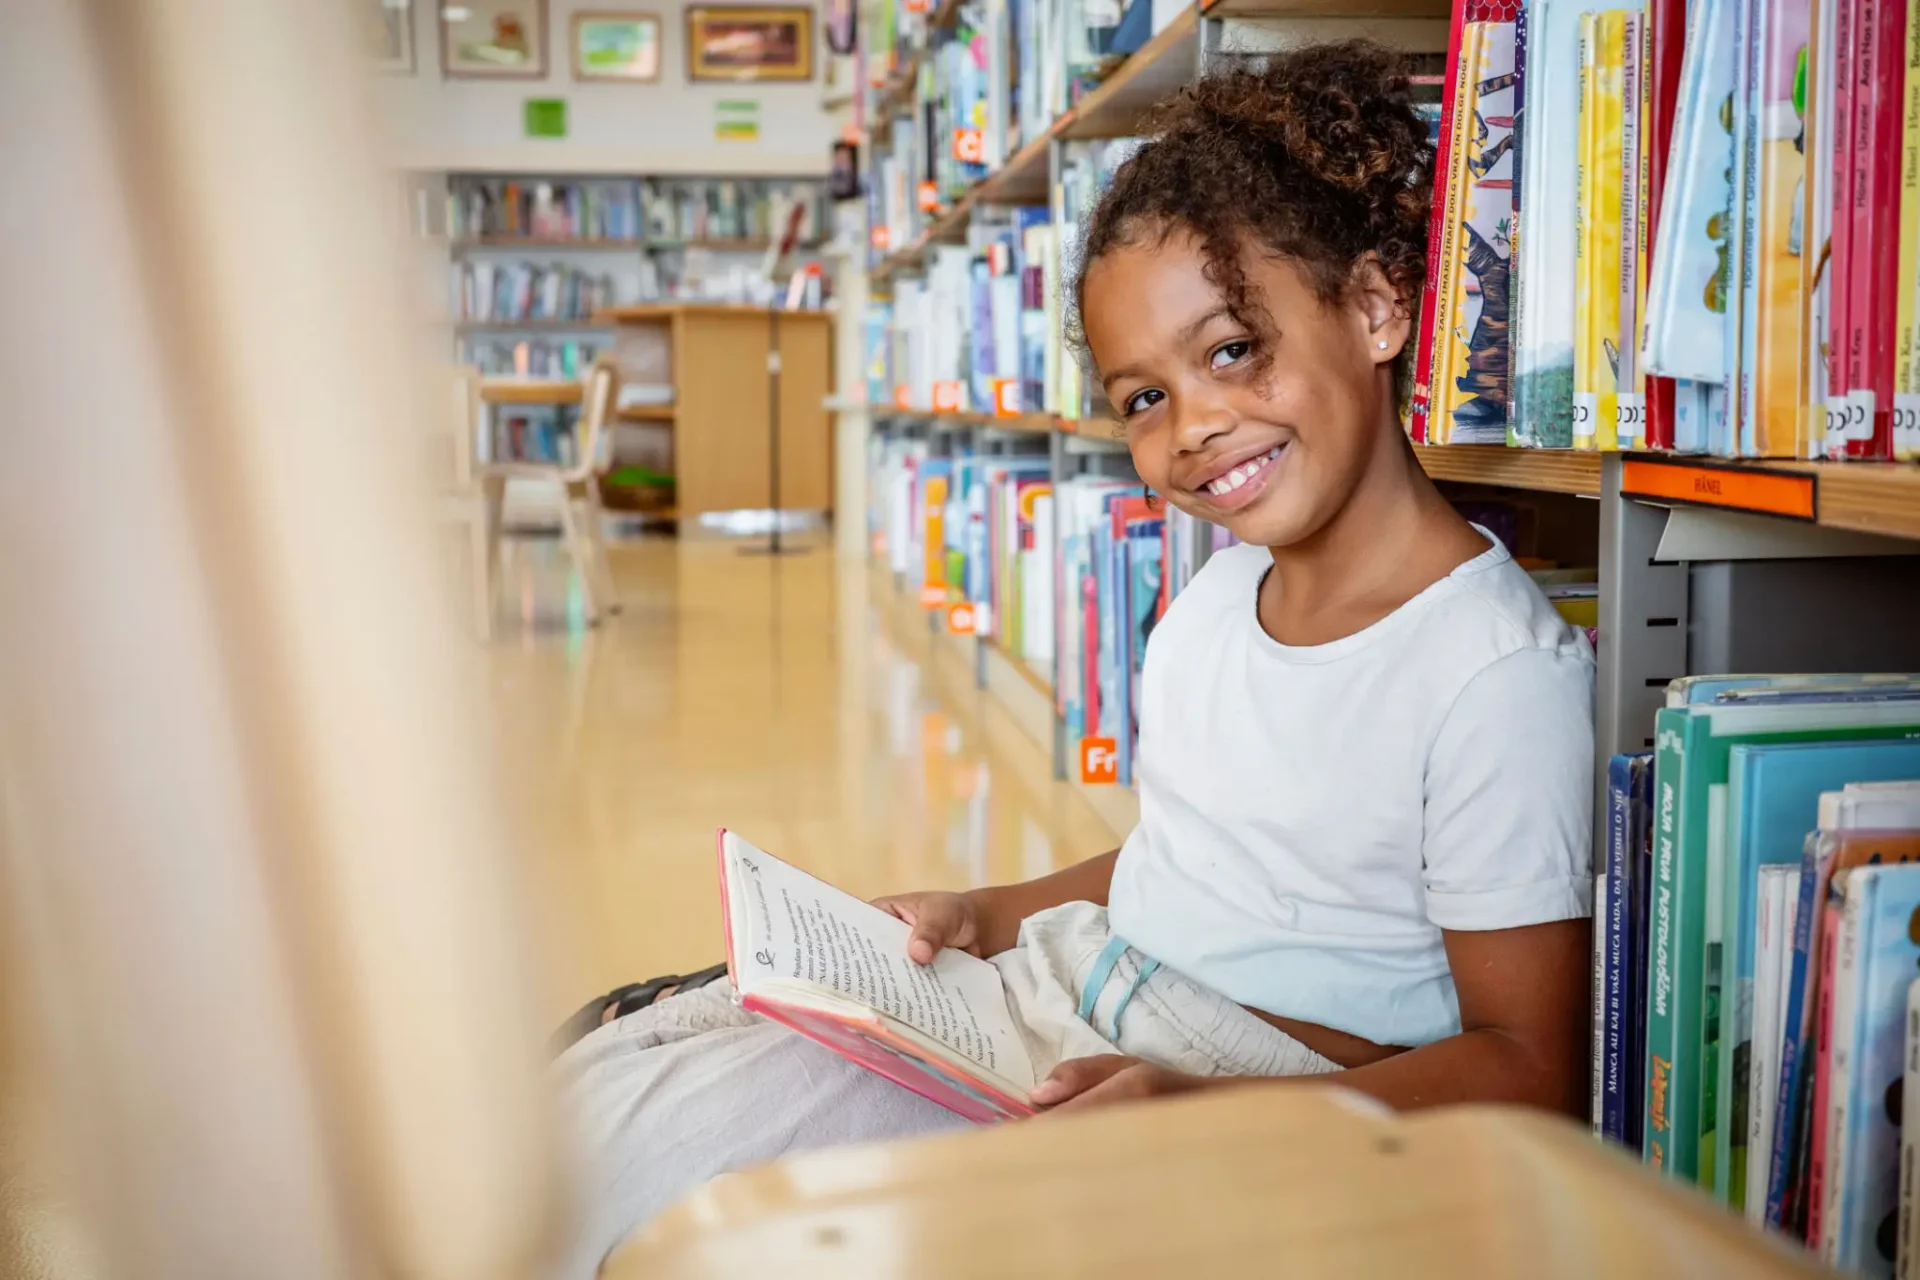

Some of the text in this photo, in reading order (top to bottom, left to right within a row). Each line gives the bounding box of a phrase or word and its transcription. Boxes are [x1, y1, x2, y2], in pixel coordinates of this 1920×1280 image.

[1624, 20, 1634, 61] Hans
[1459, 56, 1468, 89] NOGE
[1624, 64, 1634, 113] Hagen
[1456, 92, 1466, 130] DOLGE
[1454, 133, 1462, 147] IN
[1451, 151, 1460, 180] VRAT
[1448, 183, 1458, 214] DOLG
[1444, 216, 1454, 258] ŽIRAFE
[1442, 260, 1451, 295] IMAJO
[1438, 297, 1448, 332] ZAKAJ
[1430, 377, 1442, 413] Jolanda
[1615, 814, 1622, 824] O
[1662, 781, 1674, 833] MOJA
[1660, 836, 1672, 882] PRVA
[1614, 880, 1622, 895] DA
[1612, 934, 1620, 966] MUCA
[1610, 969, 1620, 995] VAŠA
[1612, 998, 1619, 1009] BI
[1610, 1012, 1620, 1030] KAJ
[1610, 1032, 1618, 1050] ALI
[1608, 1052, 1618, 1094] MANCA
